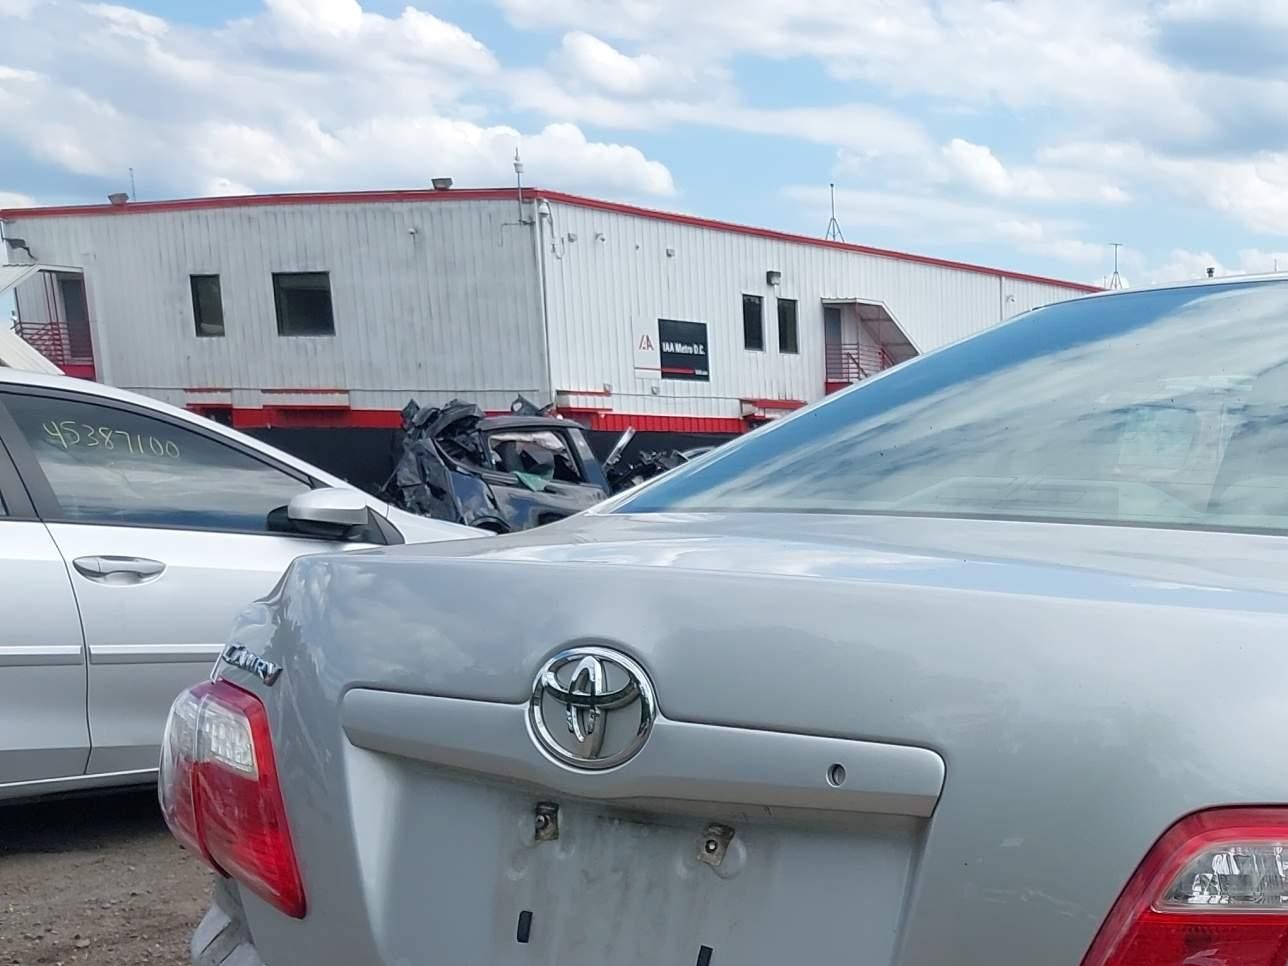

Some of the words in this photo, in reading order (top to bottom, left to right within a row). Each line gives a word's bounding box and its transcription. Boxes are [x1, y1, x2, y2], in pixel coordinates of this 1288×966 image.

[662, 342, 675, 353] IAA
[675, 343, 693, 354] Metro
[693, 344, 706, 355] D.C.
[42, 420, 181, 459] 45387100
[221, 645, 283, 687] CAMRY
